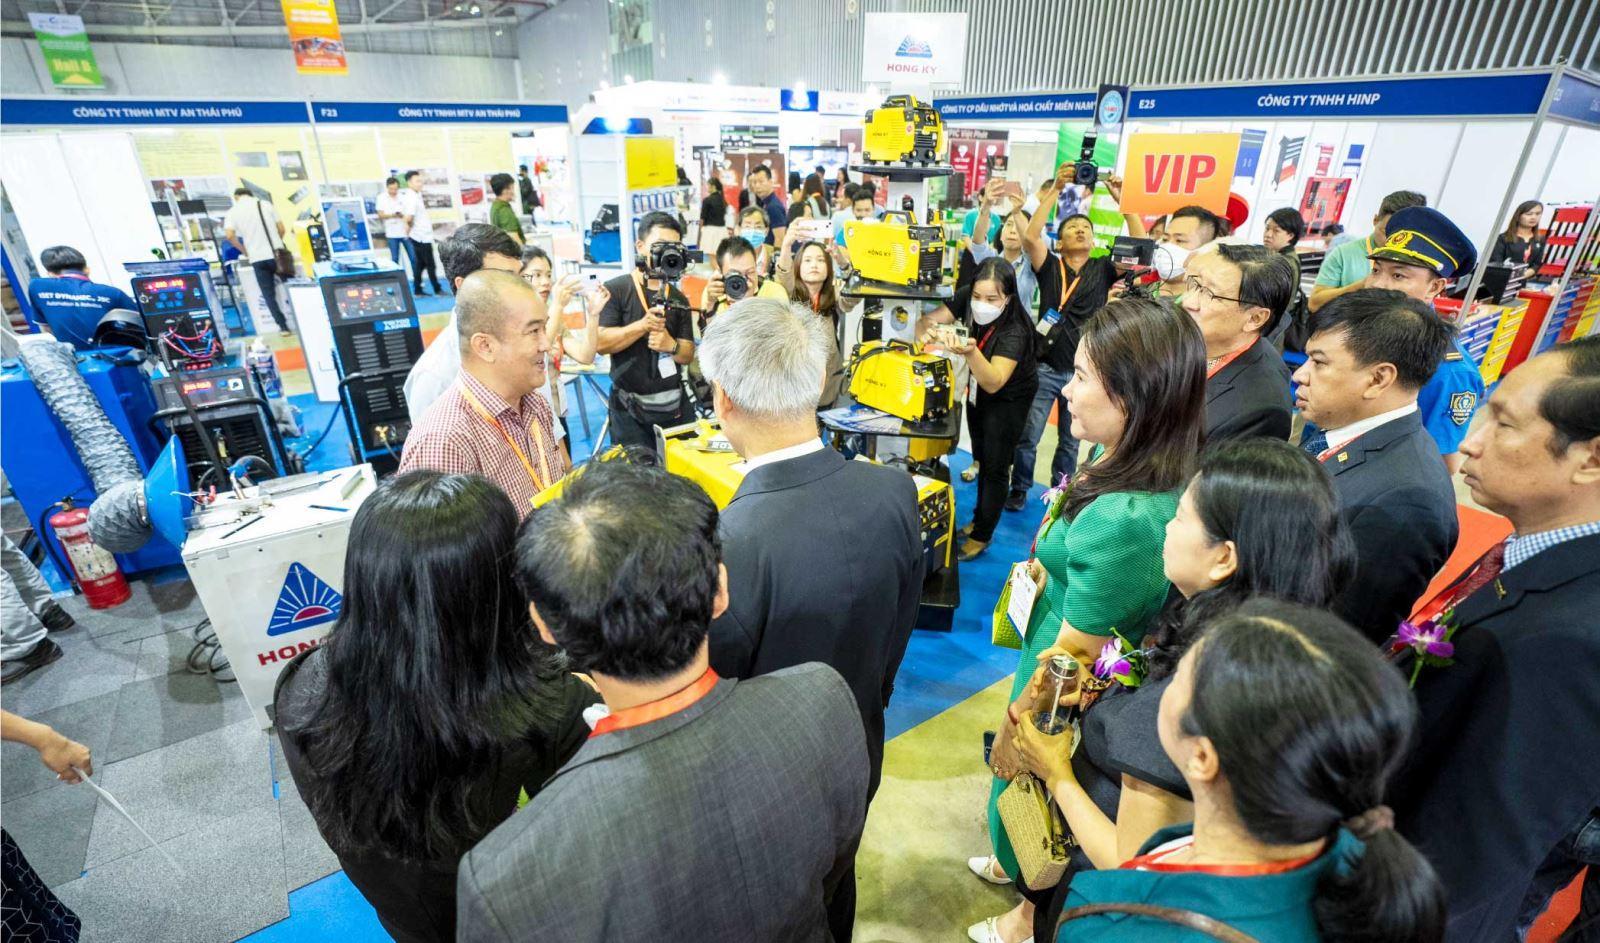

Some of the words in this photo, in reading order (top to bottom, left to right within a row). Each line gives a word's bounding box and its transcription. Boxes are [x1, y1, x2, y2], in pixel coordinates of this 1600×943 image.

[887, 63, 919, 73] HONG
[921, 65, 938, 75] KY
[1138, 99, 1156, 110] E25
[1257, 93, 1291, 107] CÔNG
[1292, 95, 1309, 106] TY
[1309, 93, 1345, 106] TNHH
[1346, 92, 1381, 106] HINP
[72, 106, 106, 118] CÔNG
[106, 107, 121, 118] TY
[122, 107, 154, 118] TNHH
[154, 107, 178, 118] MTV
[180, 107, 196, 118] AN
[195, 106, 220, 118] THÁI
[321, 108, 338, 118] F23
[398, 106, 423, 118] CÔNG
[422, 108, 433, 118] TY
[433, 108, 456, 118] TNHH
[456, 108, 474, 118] MTV
[474, 108, 487, 118] AN
[941, 104, 958, 114] CÔNG
[958, 105, 966, 113] TY
[1144, 154, 1216, 194] VIP
